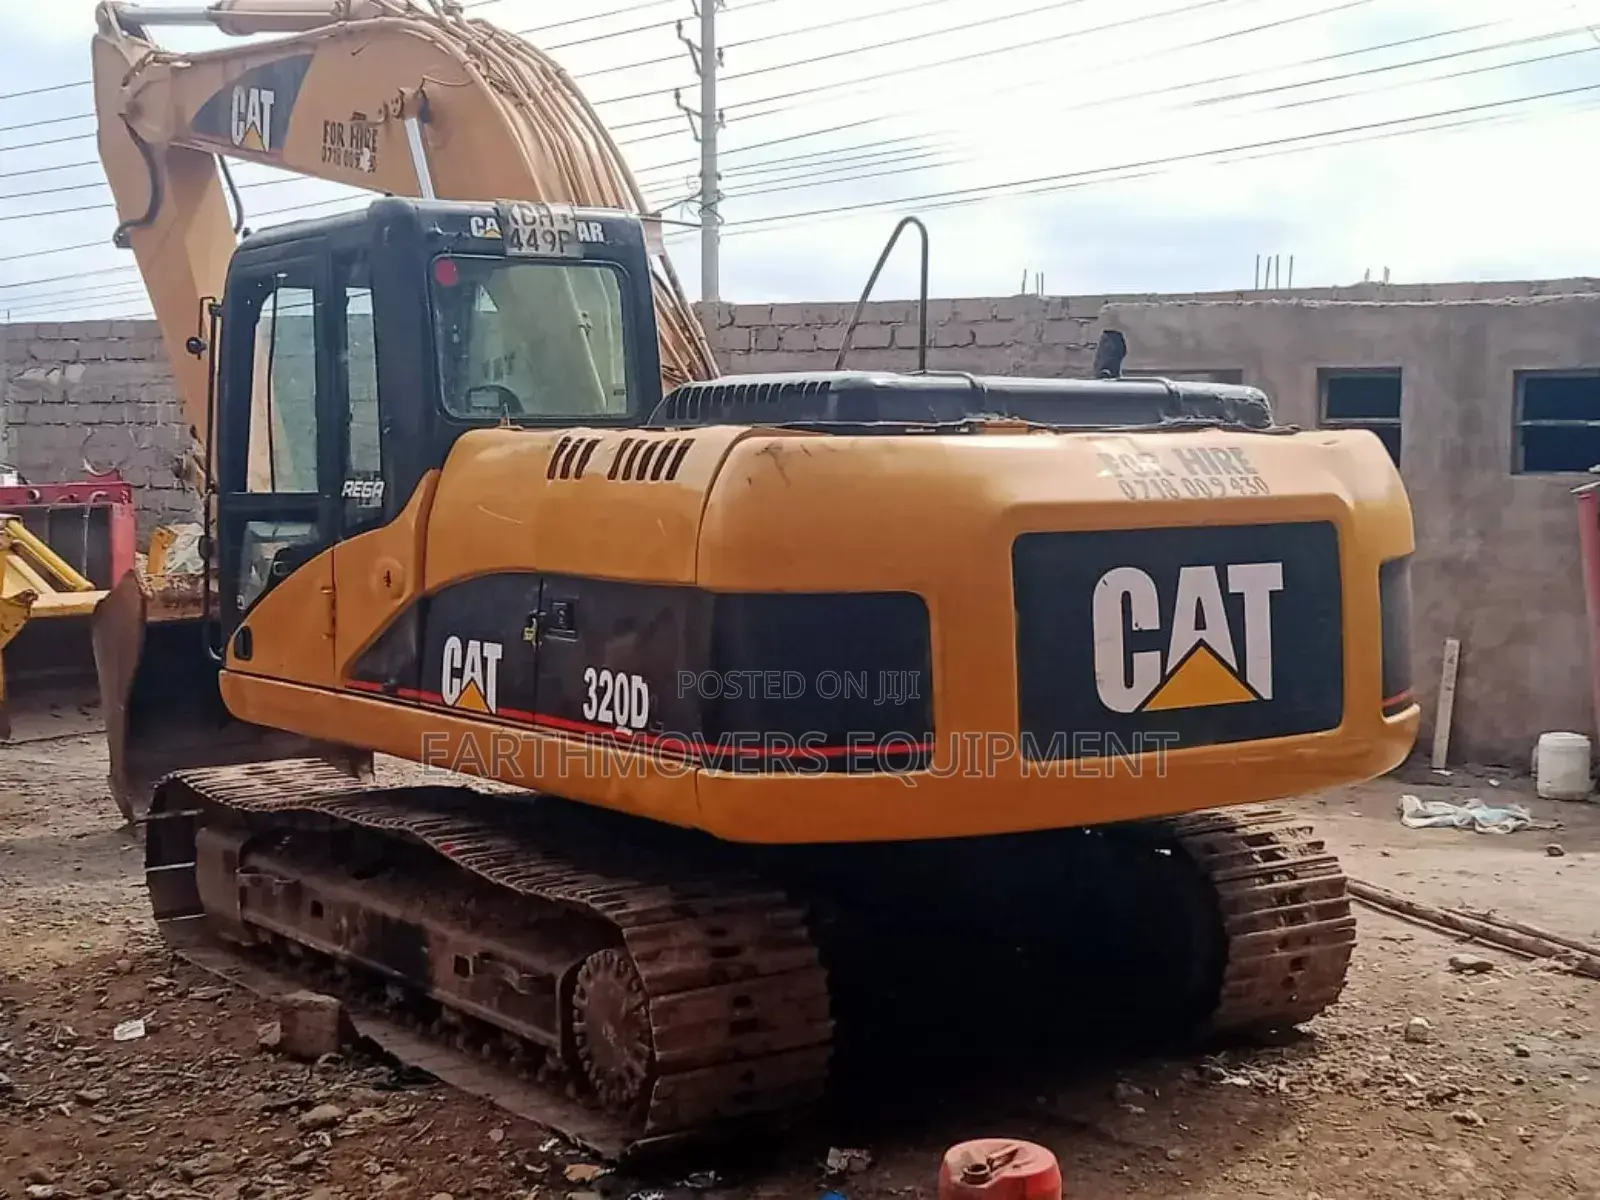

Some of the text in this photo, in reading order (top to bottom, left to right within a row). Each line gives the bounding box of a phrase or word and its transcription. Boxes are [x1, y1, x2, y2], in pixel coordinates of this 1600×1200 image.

[231, 85, 275, 152] CAT
[323, 120, 378, 152] FOR HIRE
[1096, 447, 1259, 478] FOR HIRE
[1117, 478, 1181, 500] 0718
[1180, 477, 1226, 500] 009
[1092, 561, 1284, 714] CAT
[442, 636, 502, 714] CAT
[582, 667, 649, 729] 320D
